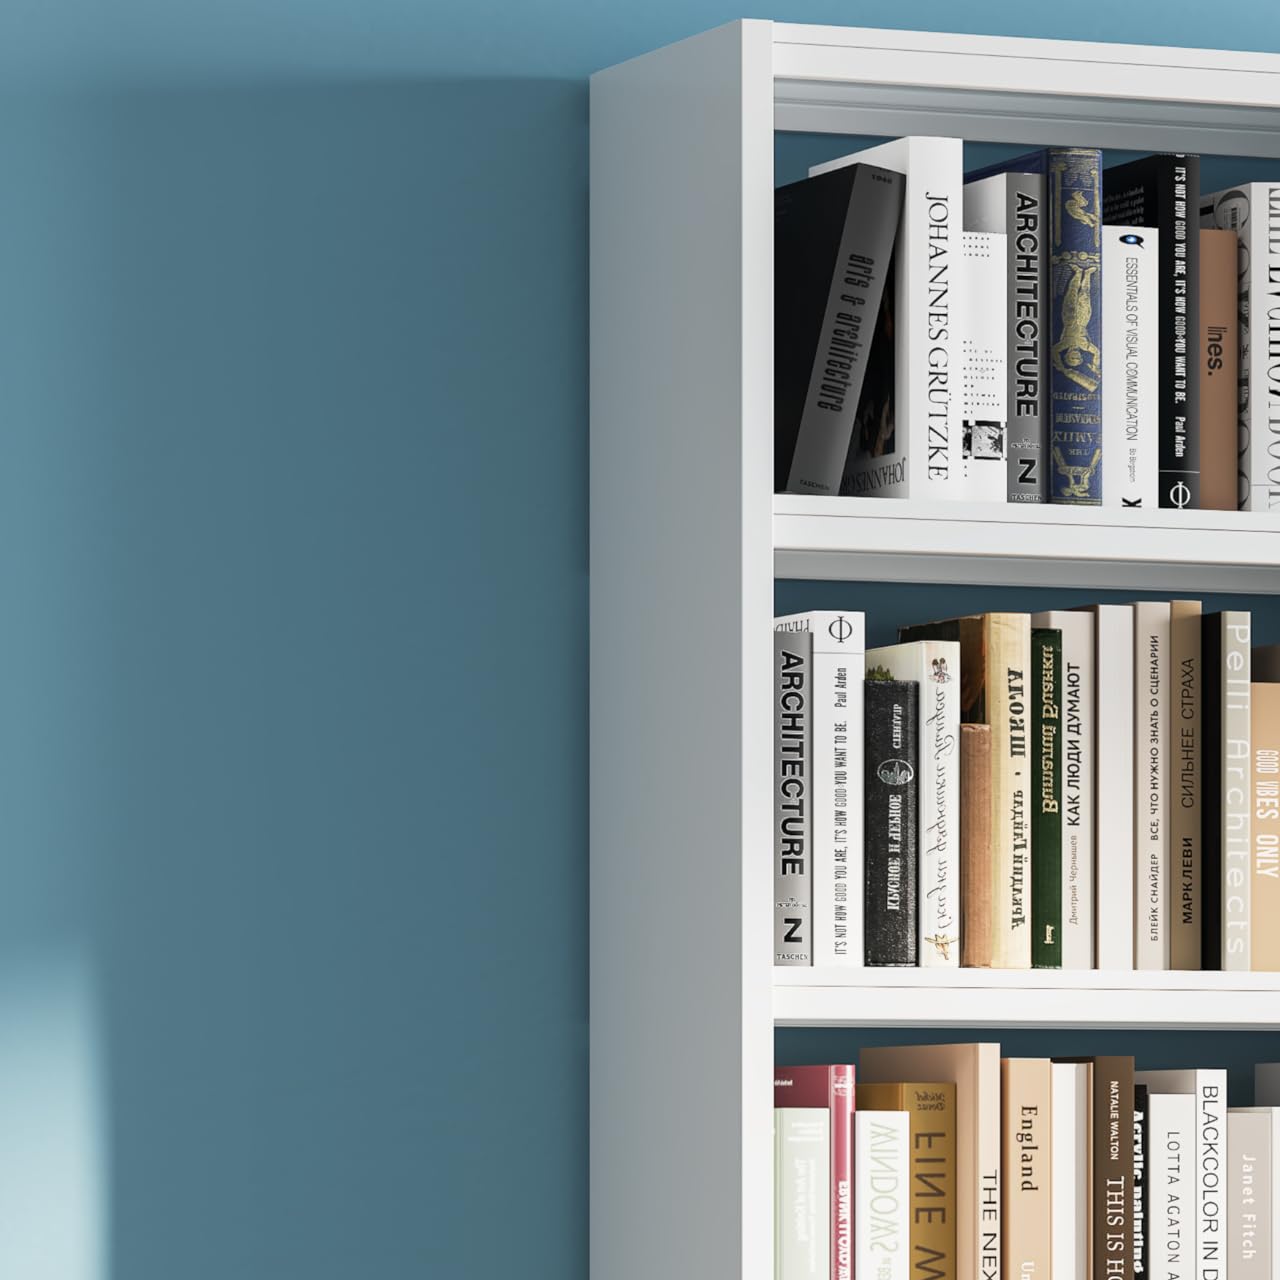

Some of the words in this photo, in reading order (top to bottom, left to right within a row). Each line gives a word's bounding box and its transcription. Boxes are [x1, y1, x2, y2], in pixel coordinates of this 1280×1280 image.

[1174, 167, 1186, 181] IT'S
[1174, 184, 1186, 198] NOT
[1174, 201, 1186, 218] HOW
[1174, 221, 1186, 239] GOOD
[925, 192, 949, 341] JOHANNES
[1174, 243, 1186, 257] YOU
[1174, 260, 1186, 277] ARE,
[1126, 257, 1138, 312] ESSENTIALS
[1174, 280, 1186, 294] IT'S
[1016, 193, 1038, 416] ARCHITECTURE
[1126, 314, 1138, 327] OF
[1174, 297, 1186, 314] HOW
[1174, 316, 1186, 335] GOOD
[1126, 329, 1138, 360] VISUAL
[1174, 338, 1186, 353] YOU
[1207, 326, 1227, 376] lines.
[1174, 356, 1186, 376] WANT
[1174, 379, 1186, 389] TO
[928, 347, 951, 481] GRÜTZKE
[1126, 362, 1138, 441] COMMUNICATION
[1174, 392, 1186, 404] BE.
[1174, 417, 1186, 433] Paul
[1174, 435, 1186, 457] Arden
[1149, 636, 1159, 695] СЦЕНАРИИ
[1225, 625, 1249, 710] Pelli
[1067, 663, 1080, 735] ДУМАЮТ
[1149, 699, 1159, 707] О
[1181, 659, 1195, 719] СТРАХА
[1149, 711, 1159, 744] ЗНАТЬ
[781, 651, 804, 875] ARCHITECTURE
[1067, 739, 1080, 790] ЛЮДИ
[1149, 748, 1159, 790] НУЖНО
[1181, 728, 1195, 808] СИЛЬНЕЕ
[1256, 750, 1278, 773] GOOD
[1067, 796, 1080, 826] КАК
[1149, 794, 1159, 815] ЧТО
[1256, 781, 1278, 819] VIBES
[1149, 819, 1159, 840] ВСЕ,
[1225, 739, 1249, 954] Architects
[1182, 838, 1192, 878] ЛЕВИ
[1256, 834, 1278, 878] ONLY
[1149, 854, 1159, 904] СНАЙДЕР
[1182, 882, 1192, 924] МАРК
[1149, 908, 1159, 941] БЛЕЙК
[1110, 1081, 1119, 1118] NATALIE
[1016, 1105, 1038, 1191] England
[1110, 1121, 1119, 1160] WALTON
[1167, 1132, 1180, 1185] LOTTA
[1202, 1086, 1219, 1232] BLACKCOLOR
[982, 1170, 997, 1221] THE
[1106, 1176, 1124, 1225] THIS
[1106, 1233, 1124, 1251] IS
[1167, 1194, 1180, 1263] AGATON
[1202, 1241, 1219, 1261] IN
